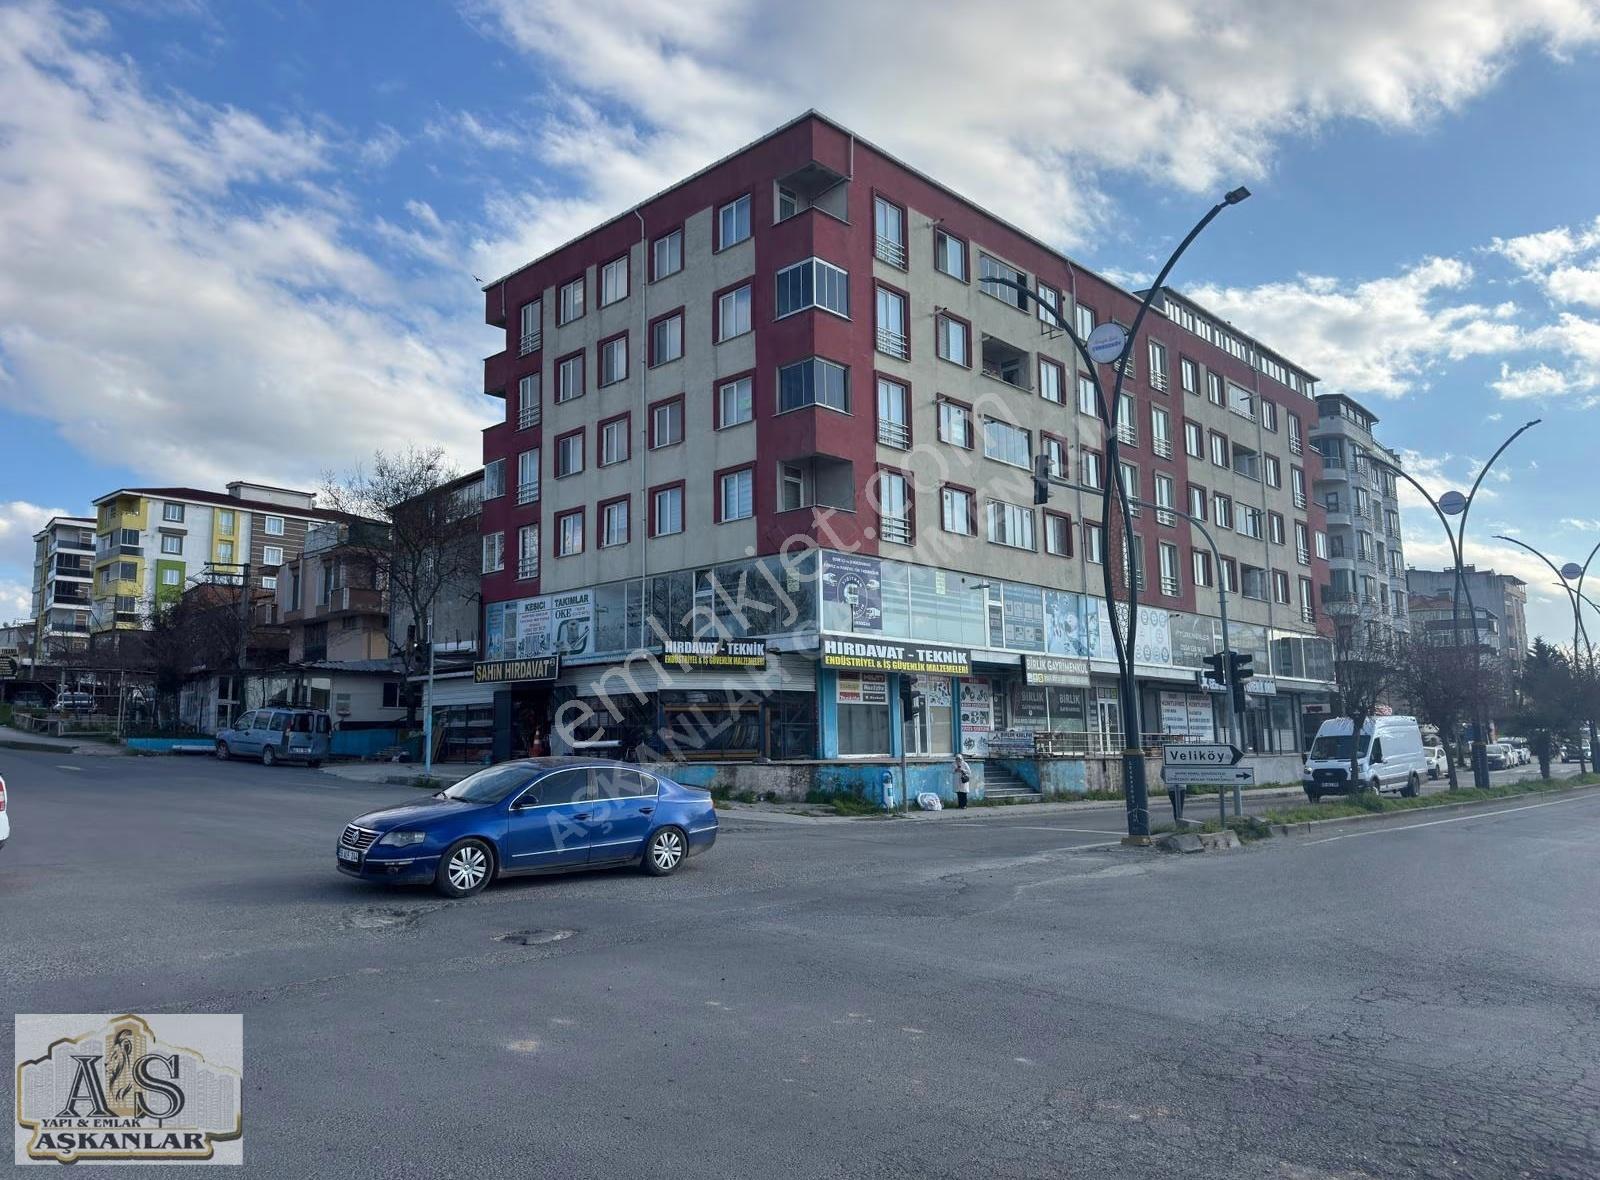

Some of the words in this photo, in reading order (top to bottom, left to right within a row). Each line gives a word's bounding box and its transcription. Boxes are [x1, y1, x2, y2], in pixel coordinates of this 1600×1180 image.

[664, 641, 719, 654] HIRDAVAT
[727, 642, 765, 656] TEKNİK
[824, 641, 905, 659] HIRDAVAT
[916, 650, 969, 664] TEKNİK
[505, 660, 549, 680] HIRDAVAT
[825, 655, 876, 668] ENDÜSTRİYEL
[892, 661, 926, 671] GÜVENLİK
[926, 663, 969, 675] MALZEMELERİ
[1170, 750, 1225, 763] Veliköy
